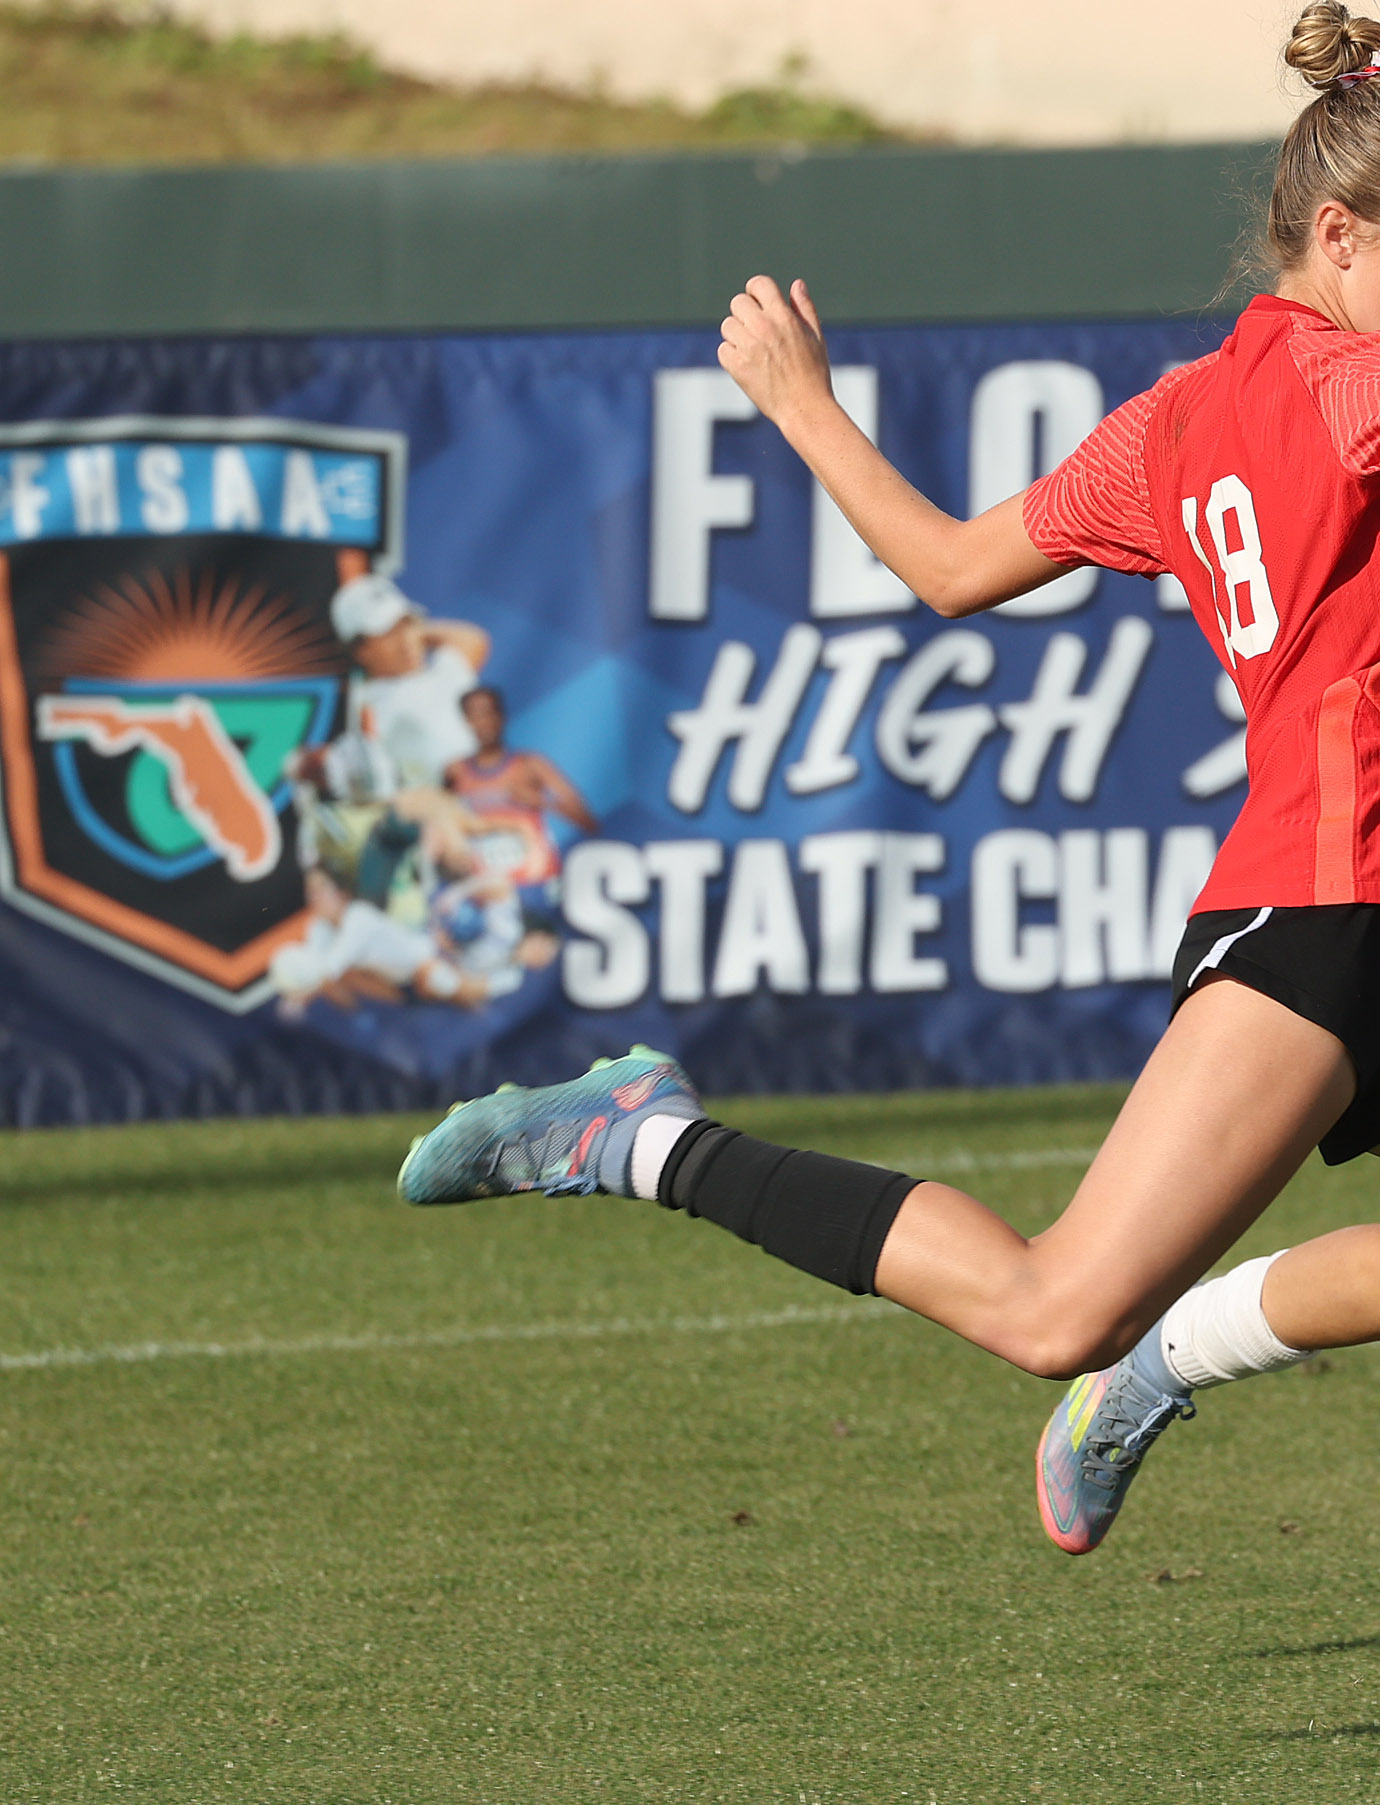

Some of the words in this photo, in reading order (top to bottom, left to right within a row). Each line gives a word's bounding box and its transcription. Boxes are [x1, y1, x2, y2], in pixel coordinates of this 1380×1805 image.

[10, 444, 331, 538] FHSAA
[650, 361, 1194, 620] FLO
[1181, 474, 1280, 669] 18
[668, 618, 1152, 811] HIGH
[562, 832, 947, 1008] STATE
